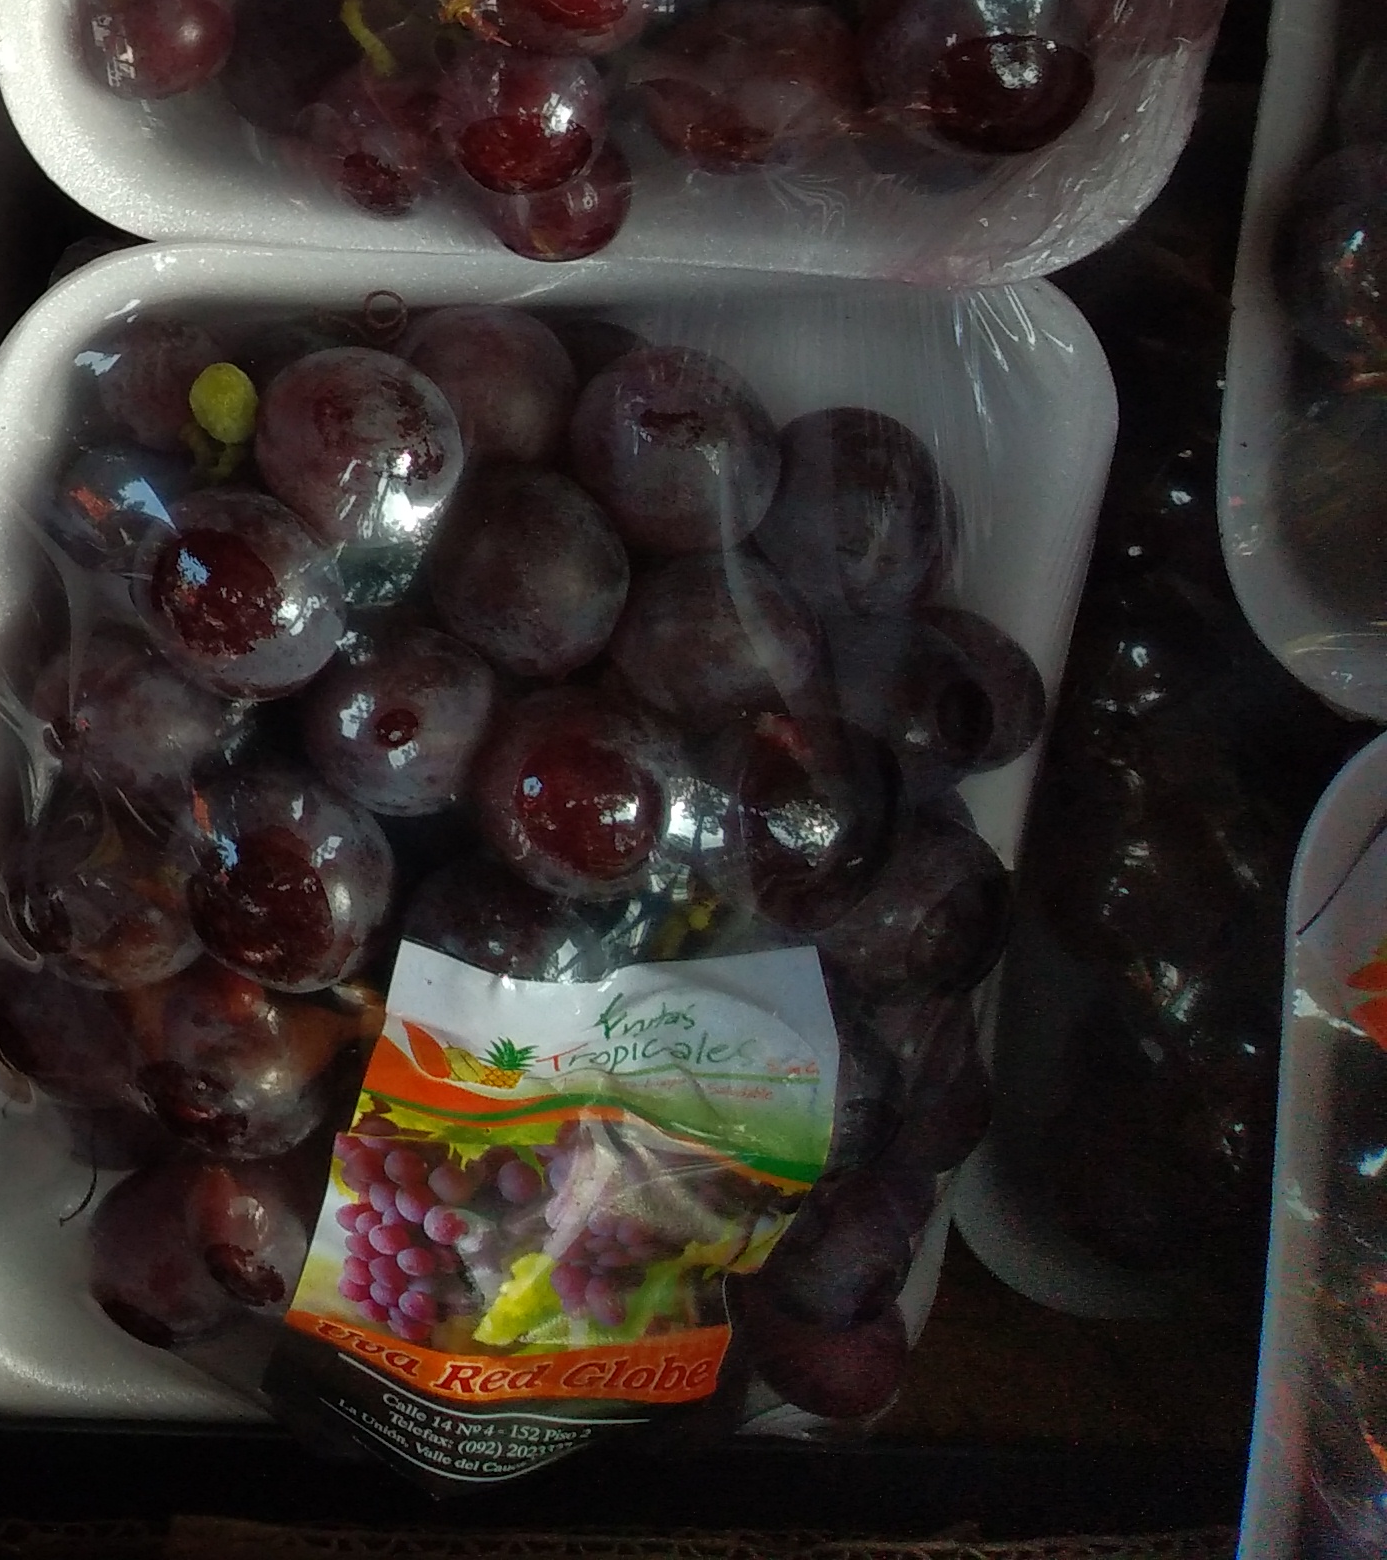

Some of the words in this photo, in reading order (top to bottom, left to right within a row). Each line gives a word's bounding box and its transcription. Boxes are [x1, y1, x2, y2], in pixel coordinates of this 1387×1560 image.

[593, 992, 695, 1040] Frutas
[536, 1031, 757, 1074] Tropicales
[318, 1319, 424, 1378] Uva
[431, 1361, 548, 1395] Red
[560, 1356, 713, 1395] Globe
[337, 1397, 358, 1417] La
[361, 1414, 410, 1449] Unión,
[414, 1441, 452, 1467] Valle
[455, 1457, 480, 1472] del
[382, 1392, 427, 1422] Calle
[431, 1416, 453, 1432] 14
[482, 1423, 495, 1436] 4
[511, 1424, 540, 1441] 152
[543, 1427, 577, 1442] Piso
[579, 1428, 592, 1439] 2
[388, 1410, 454, 1449] Telefax:
[457, 1440, 503, 1459] (092)
